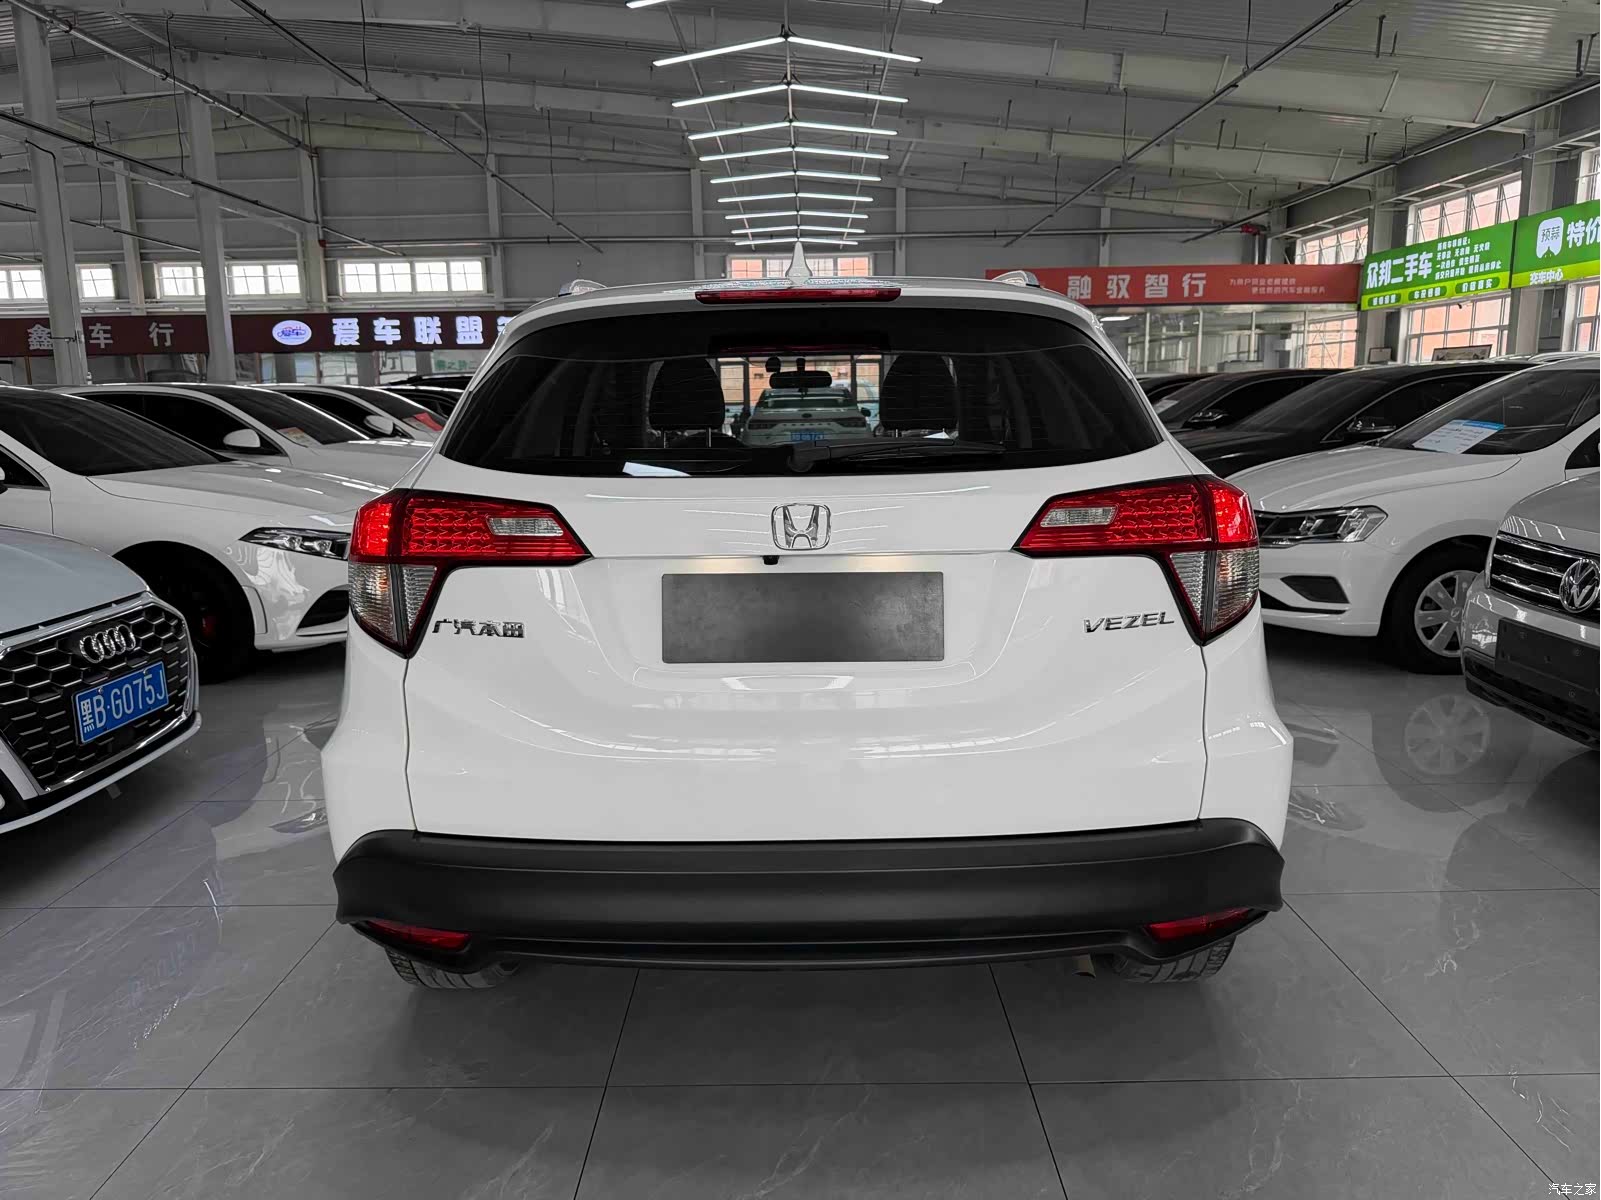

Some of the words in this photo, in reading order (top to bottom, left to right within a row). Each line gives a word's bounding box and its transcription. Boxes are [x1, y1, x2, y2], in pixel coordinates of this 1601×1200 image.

[1366, 251, 1433, 289] 众邦二手车
[1066, 272, 1207, 300] 融驭智行
[431, 618, 524, 639] 广汽本田
[1083, 611, 1175, 633] VEZEL
